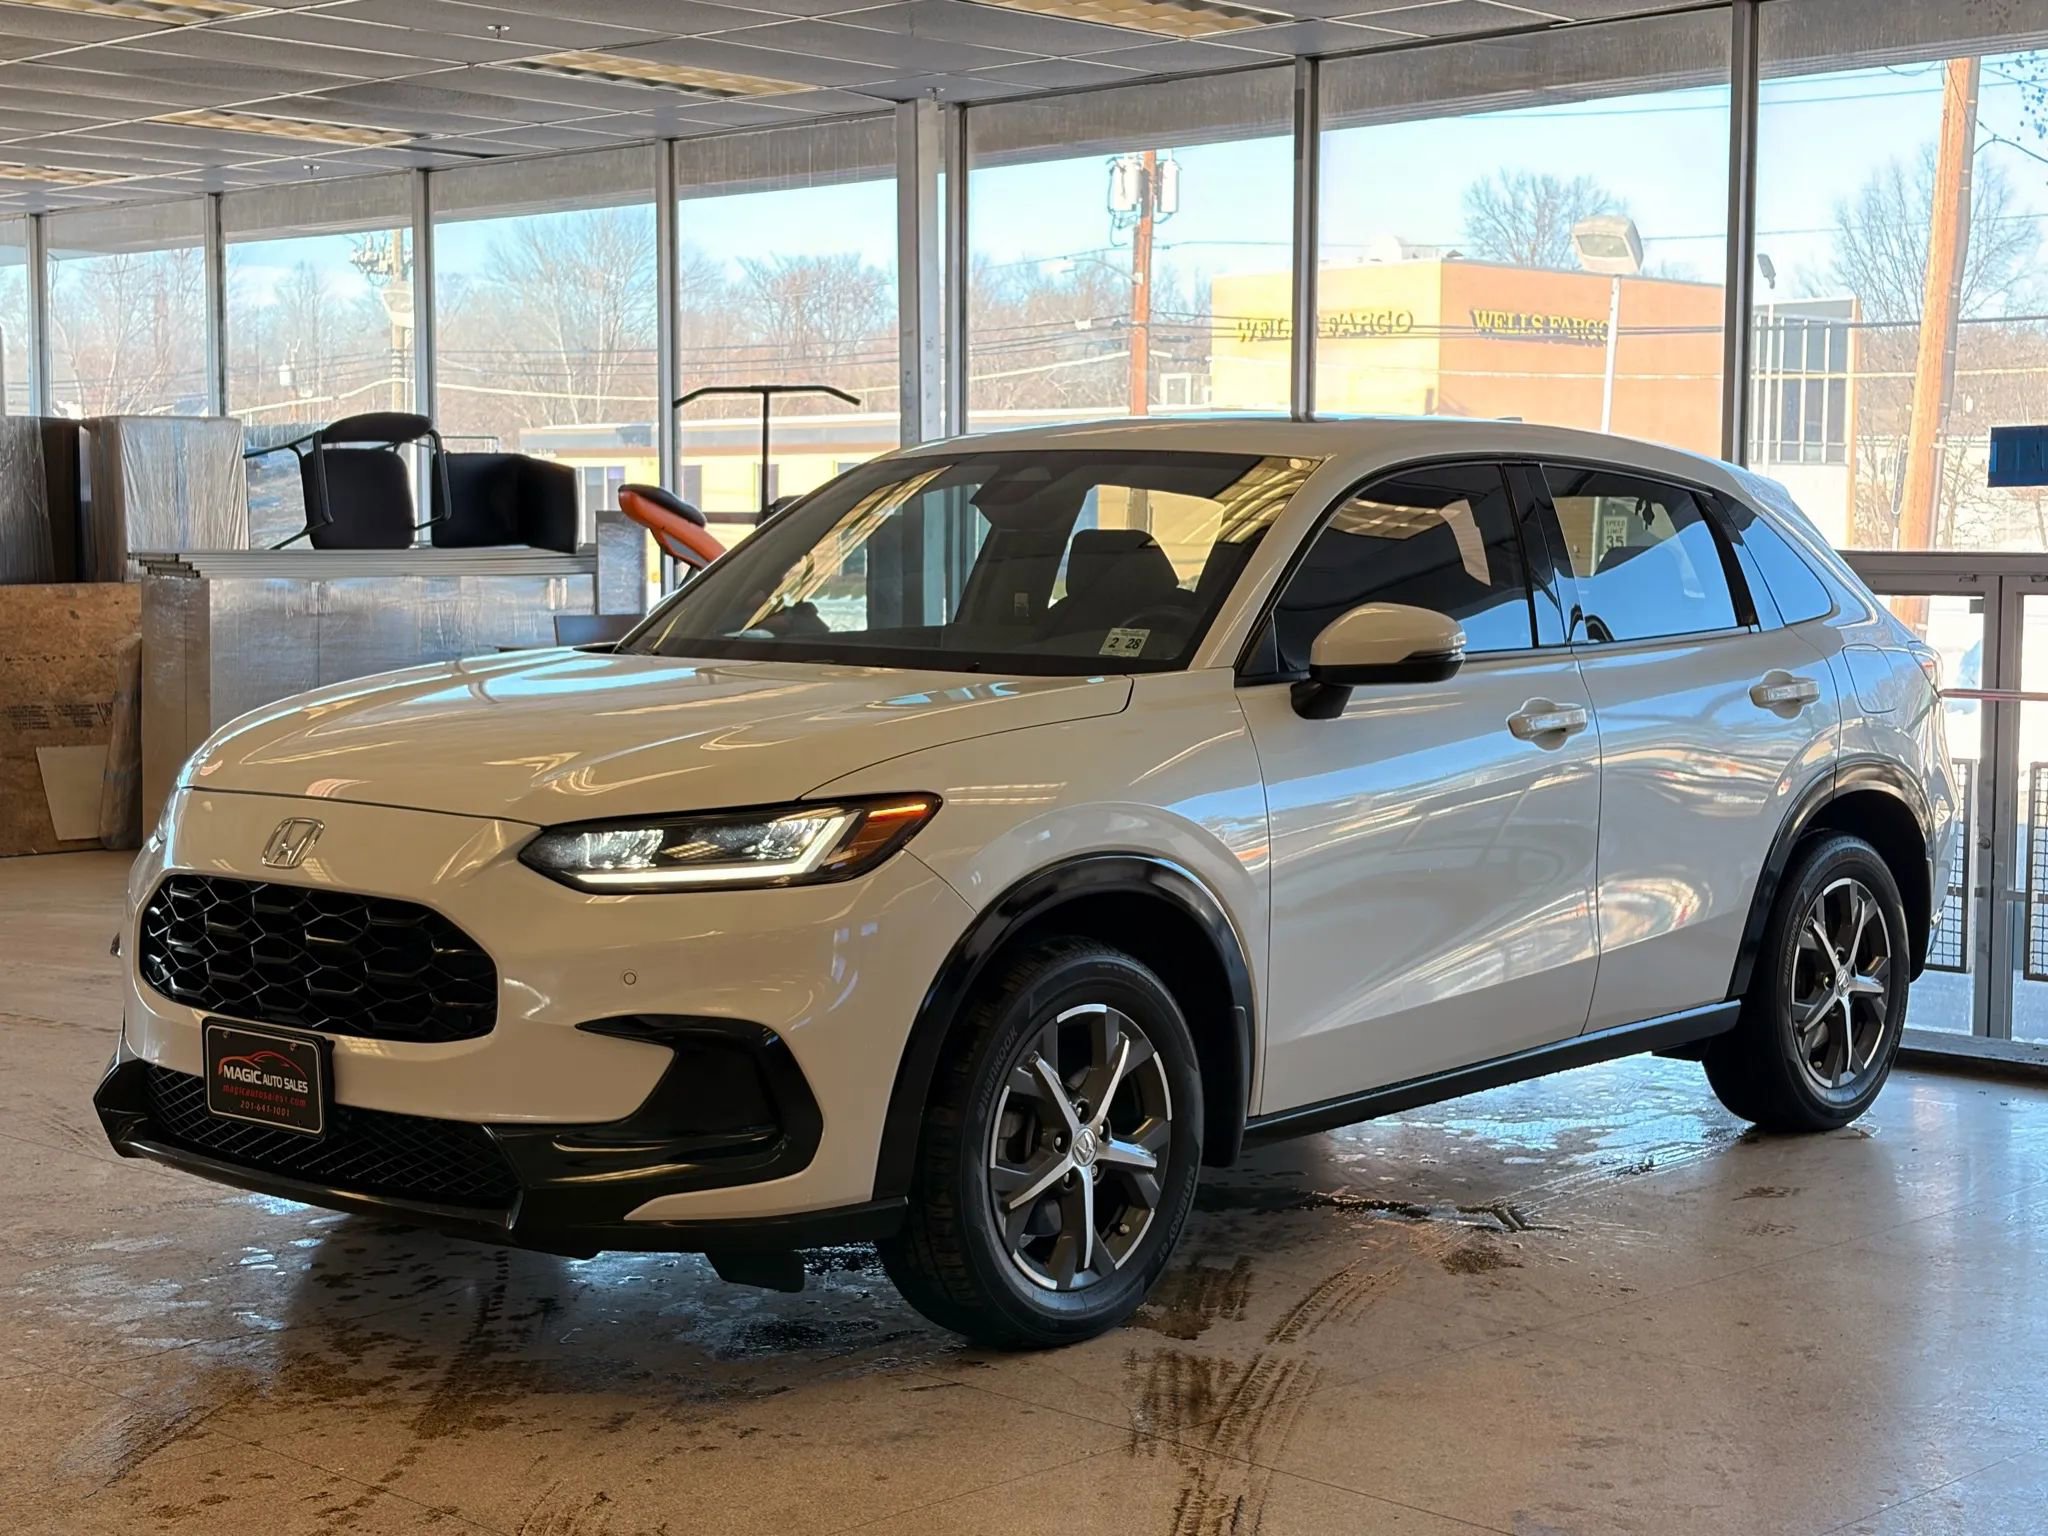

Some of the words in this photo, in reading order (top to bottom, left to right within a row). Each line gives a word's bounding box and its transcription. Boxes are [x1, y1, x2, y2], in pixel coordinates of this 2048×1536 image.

[1471, 310, 1544, 335] WELLS
[1606, 535, 1625, 549] 35
[1108, 637, 1120, 649] 2
[1124, 638, 1142, 650] 28
[223, 1064, 262, 1085] MAGIC
[262, 1073, 283, 1089] AUTO
[283, 1077, 309, 1094] SALES
[240, 1100, 291, 1117] 201-641-1001
